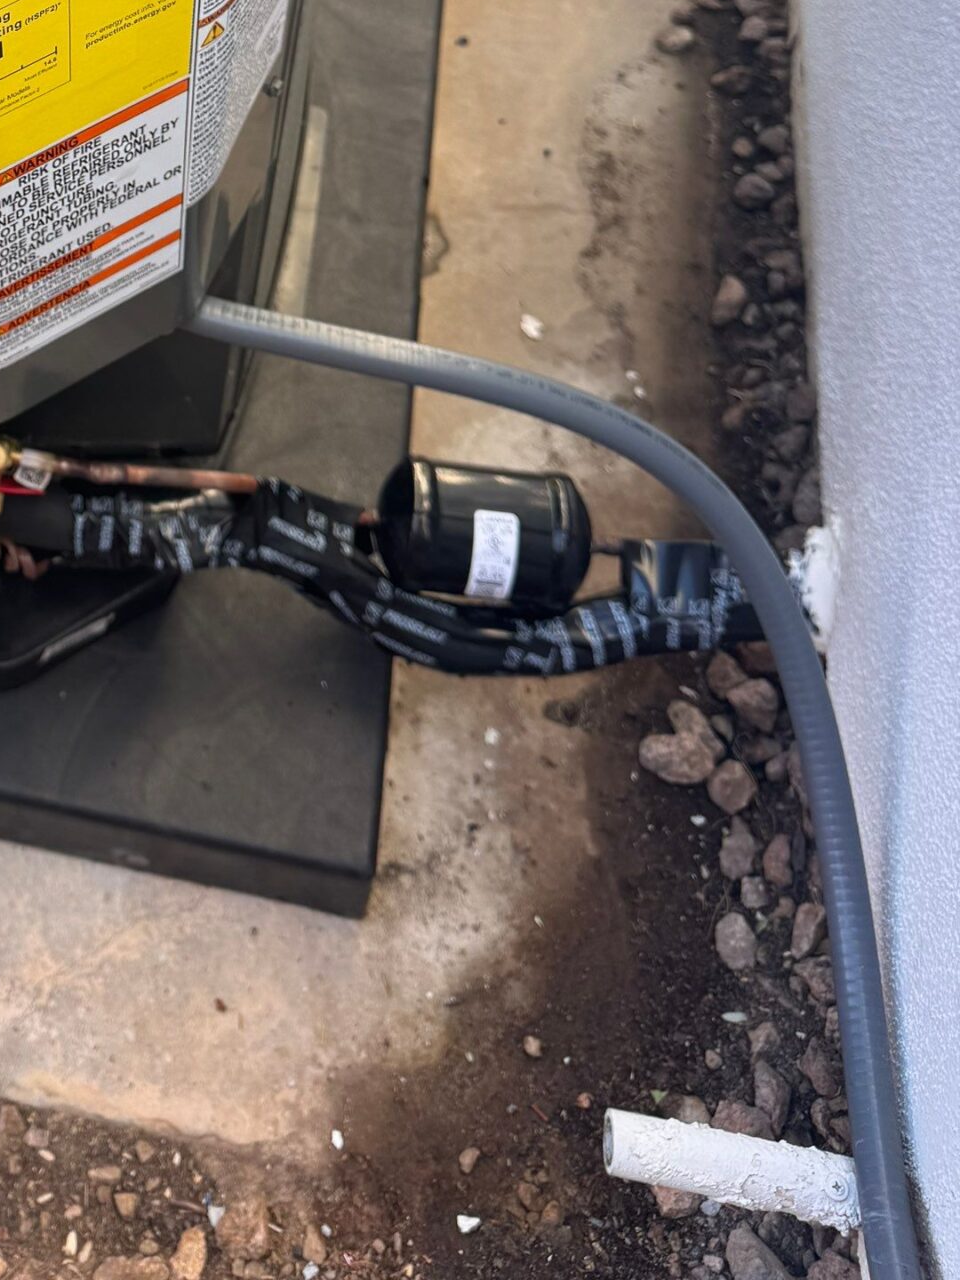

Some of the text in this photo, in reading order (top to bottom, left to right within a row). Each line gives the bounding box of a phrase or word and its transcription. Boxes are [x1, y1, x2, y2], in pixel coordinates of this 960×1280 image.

[85, 1, 177, 49] productinfo.energy.gov
[85, 29, 98, 41] For
[98, 17, 123, 33] energy
[7, 85, 31, 100] Models
[10, 196, 28, 212] TO
[32, 184, 50, 201] BE
[54, 150, 121, 187] REPAIRED
[123, 128, 157, 152] ONLY
[161, 117, 180, 134] BY
[13, 136, 79, 176] WARNING
[18, 136, 102, 187] RISK OF FIRE
[28, 175, 86, 212] SERVICE
[90, 134, 172, 176] PERSONNEL.
[53, 124, 148, 180] REFRIGERANT
[22, 182, 93, 227] PUNCTURE
[30, 225, 48, 242] OF
[52, 186, 119, 230] PROPERLY
[123, 179, 136, 193] IN
[66, 181, 118, 212] TUBING.
[66, 209, 99, 232] WITH
[102, 178, 161, 214] FEDERAL
[163, 165, 182, 180] OR
[76, 222, 114, 248] USED.
[8, 280, 91, 330] ADVERTENCIA
